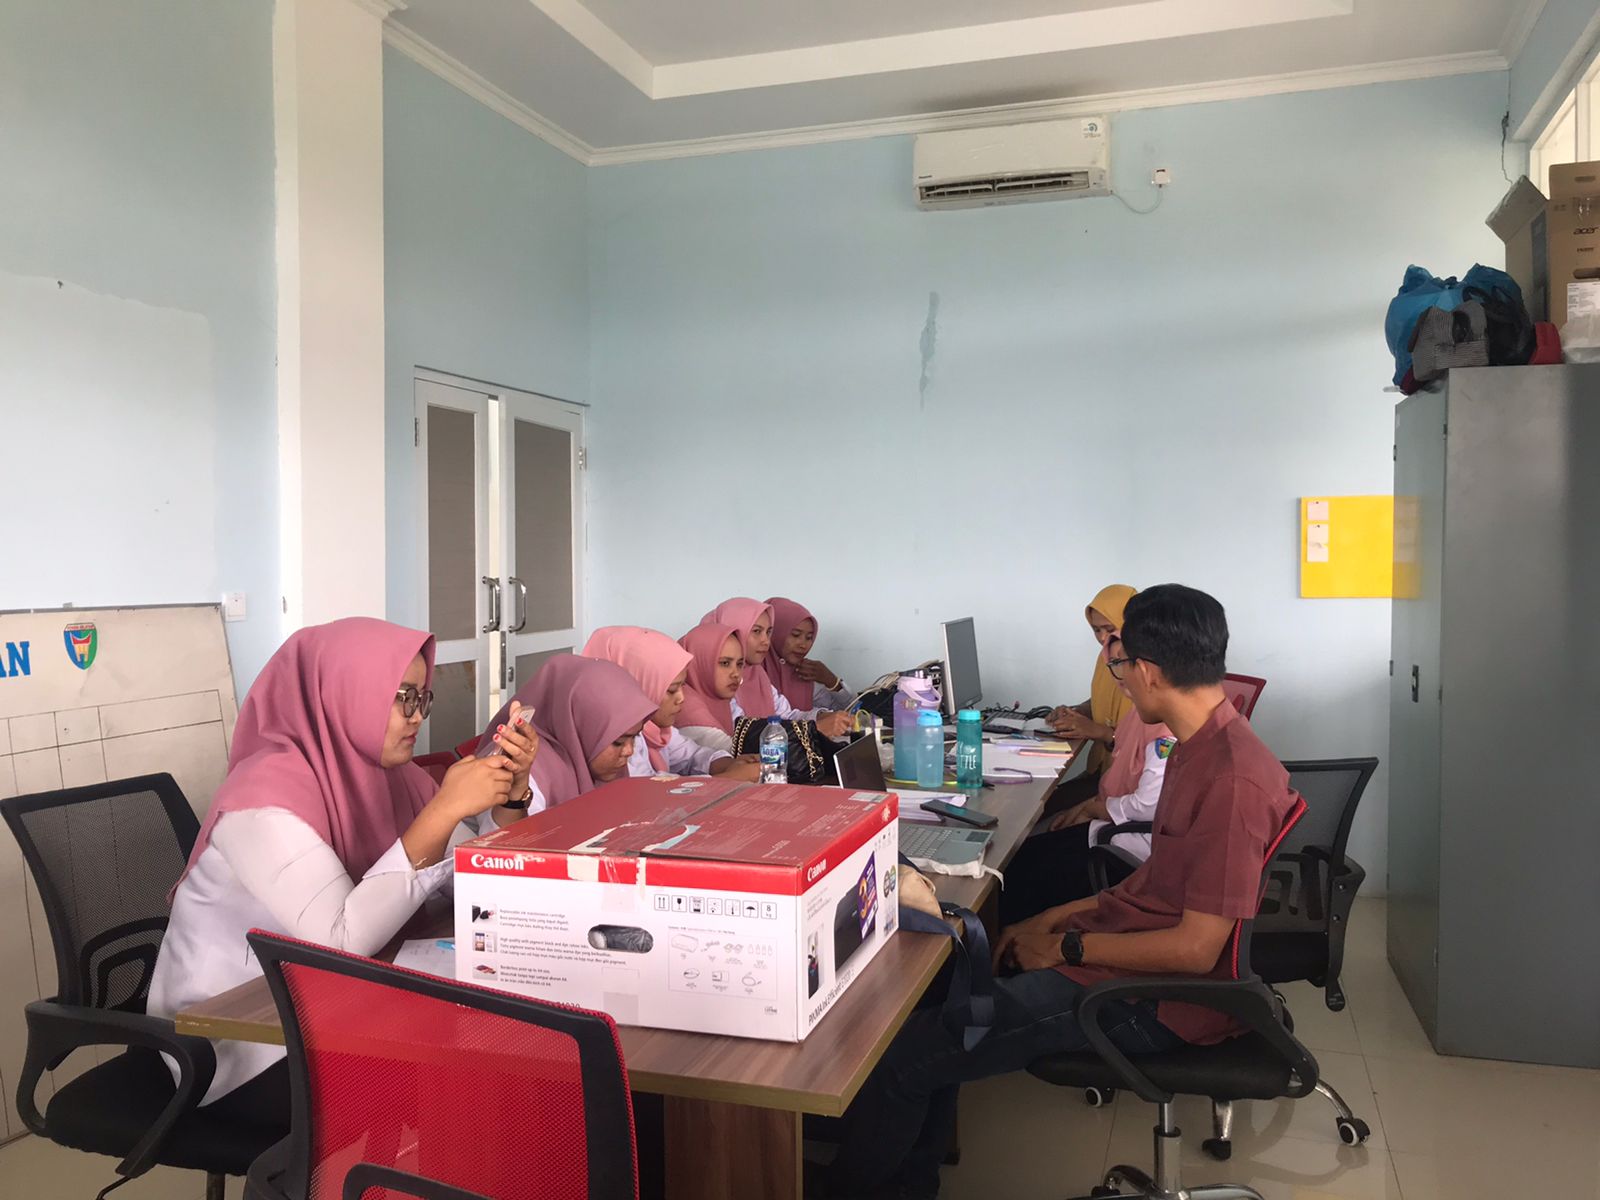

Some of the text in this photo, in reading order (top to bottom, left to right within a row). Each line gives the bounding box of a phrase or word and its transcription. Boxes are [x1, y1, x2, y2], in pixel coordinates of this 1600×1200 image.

[0, 641, 30, 677] N
[959, 755, 977, 769] TTLE
[471, 853, 524, 871] Canon
[807, 858, 827, 882] Canon
[766, 904, 772, 912] 8
